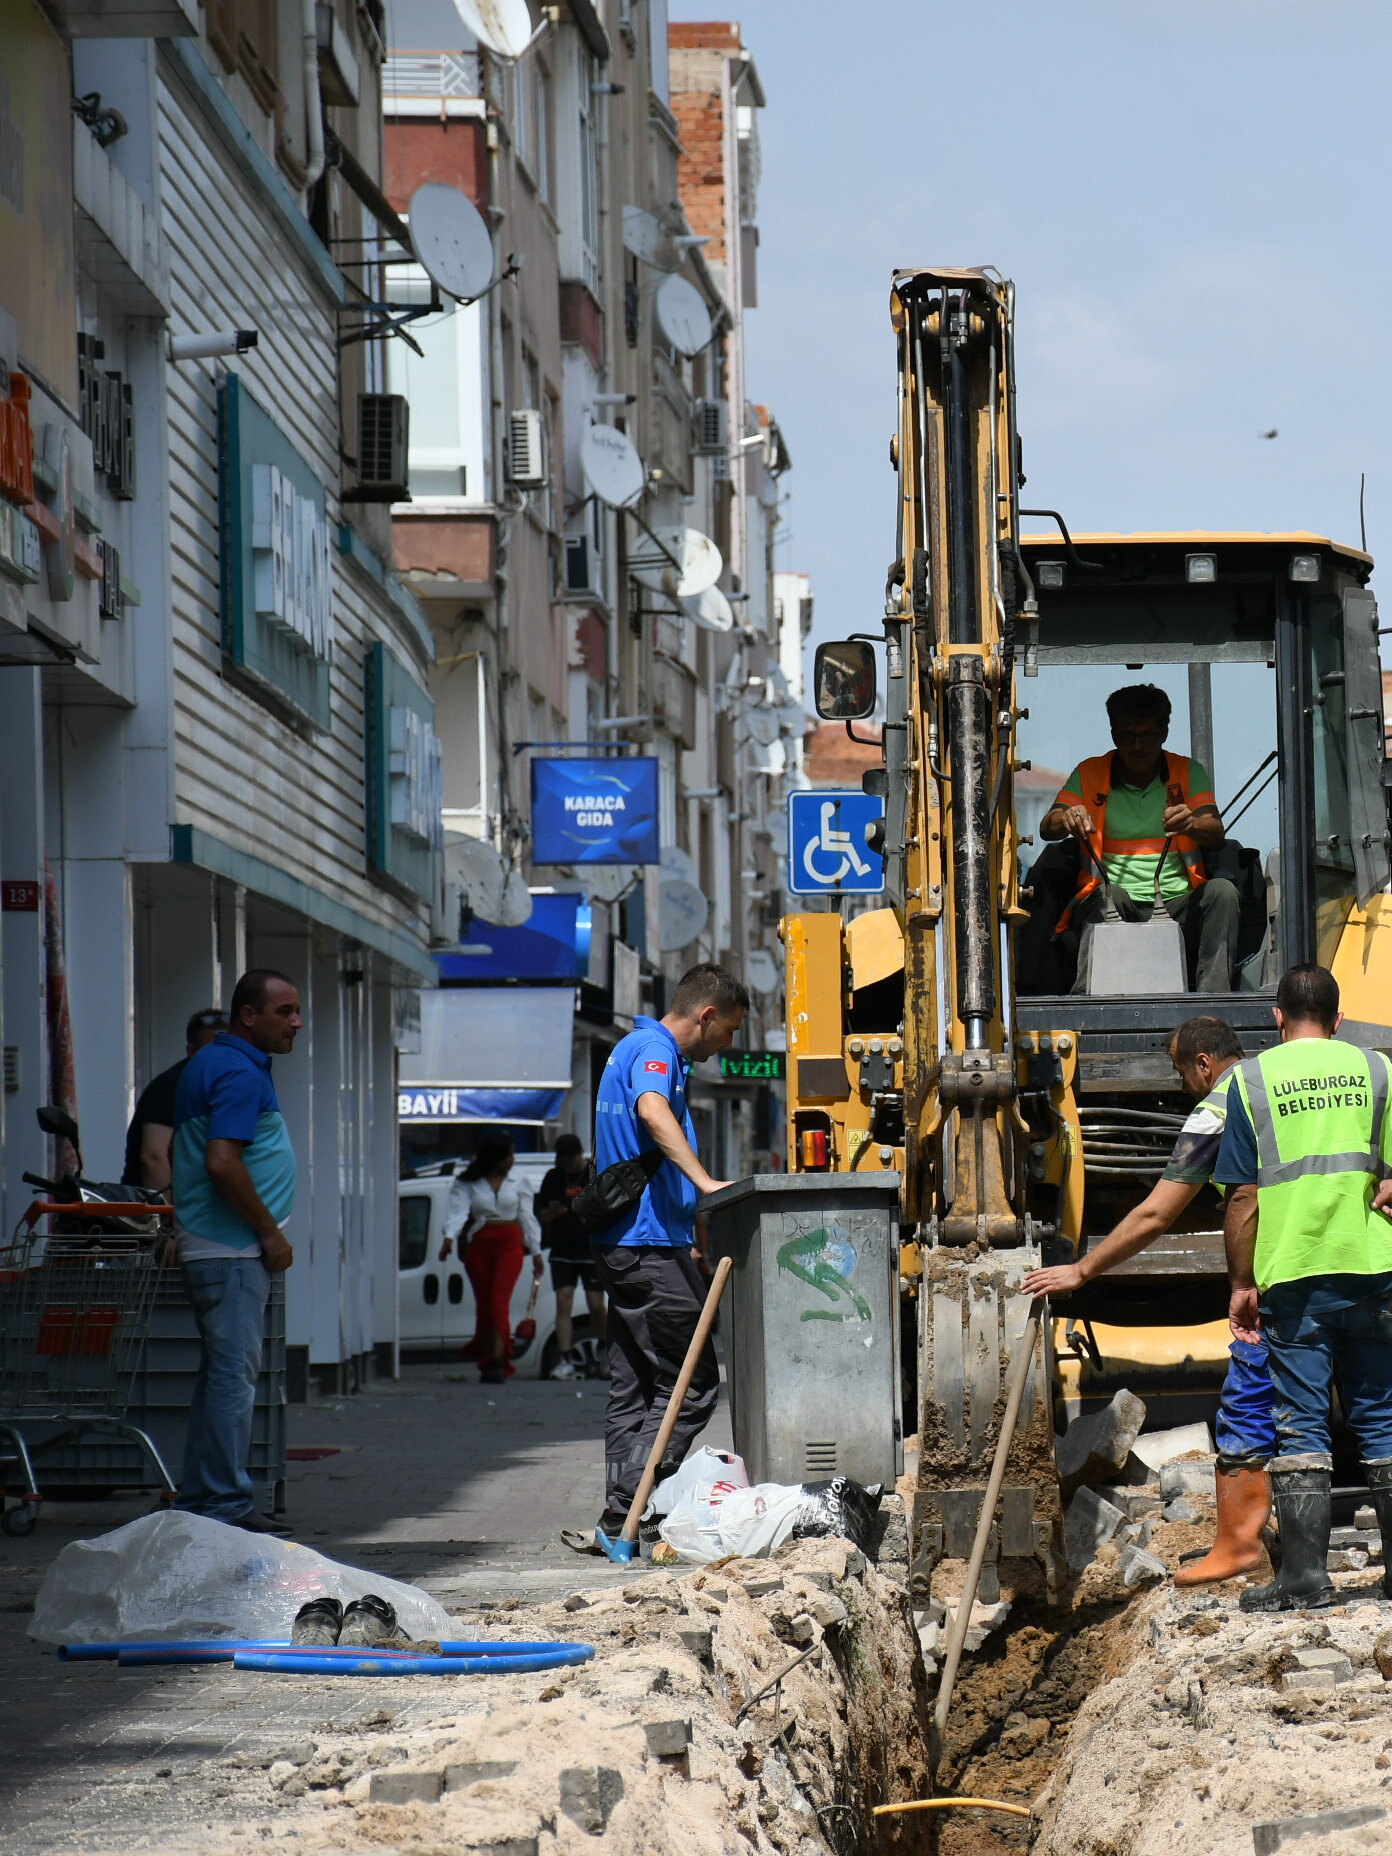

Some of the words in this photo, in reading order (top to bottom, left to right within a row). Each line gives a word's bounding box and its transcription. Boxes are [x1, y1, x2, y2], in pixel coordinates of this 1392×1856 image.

[564, 795, 626, 811] KARACA
[576, 811, 614, 827] GIDA
[1273, 1075, 1367, 1098] LÜLEBURGAZ
[1278, 1091, 1368, 1118] BELEDİYESİ
